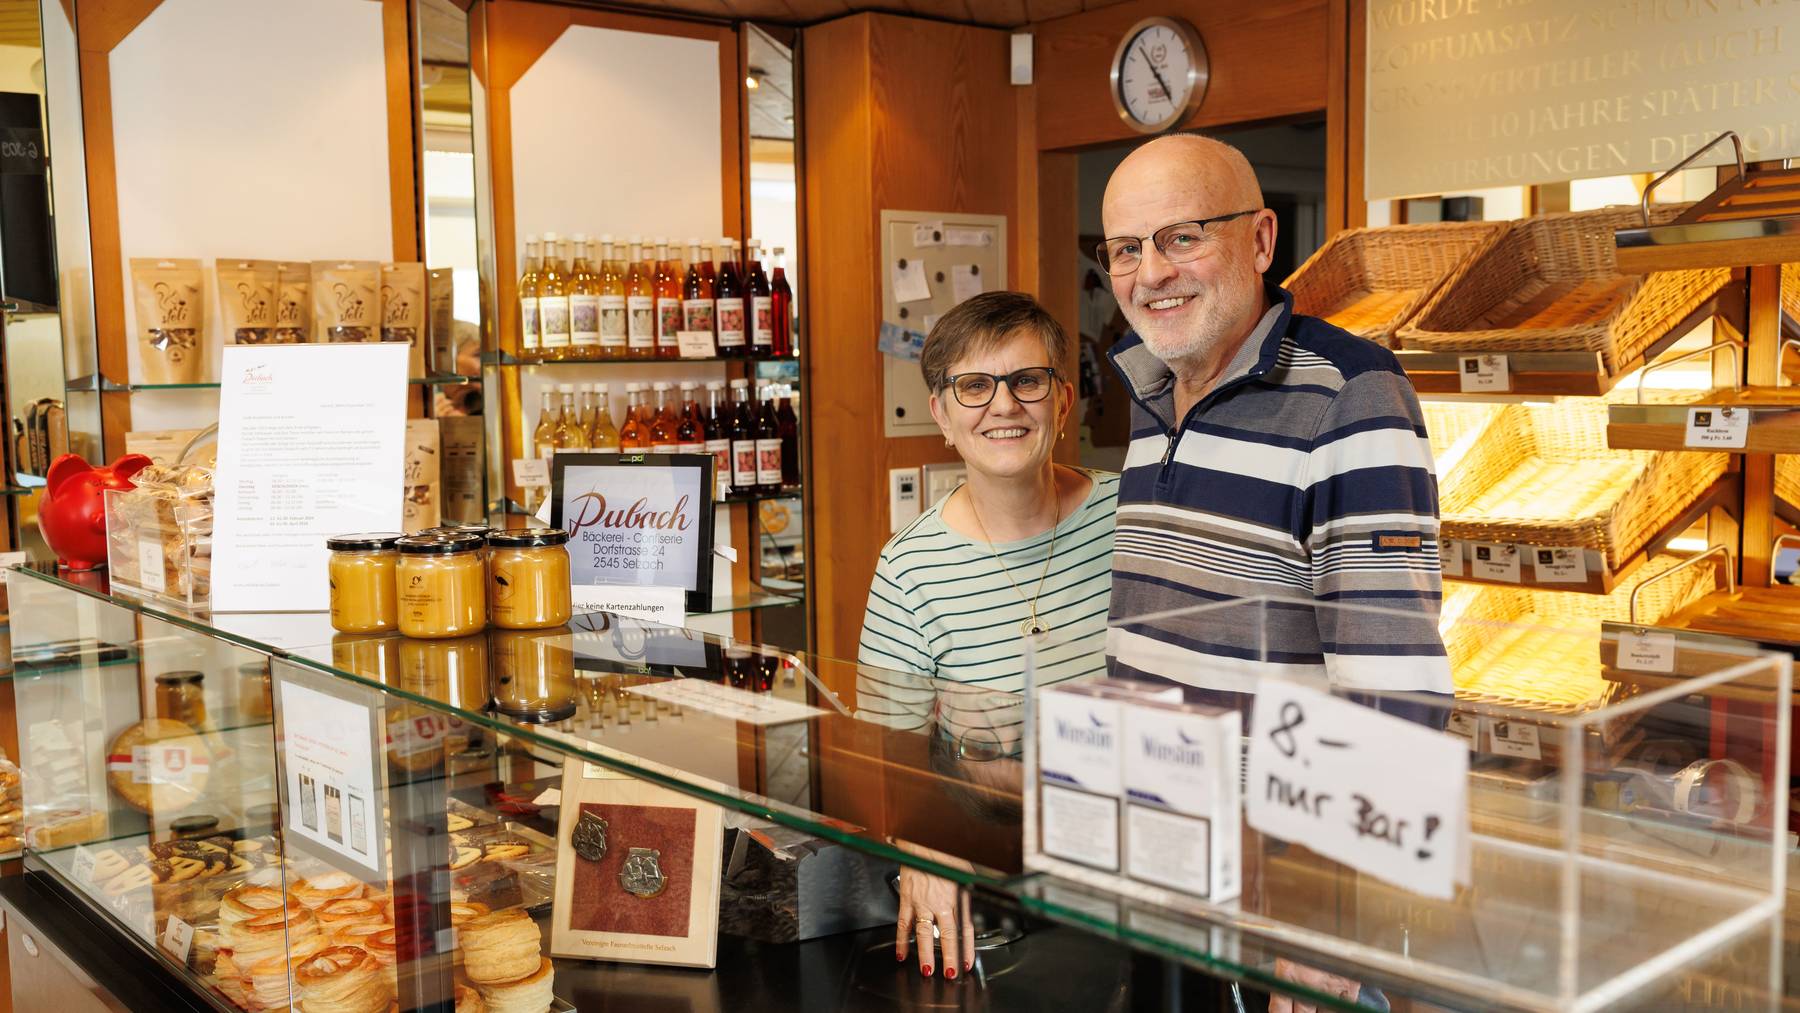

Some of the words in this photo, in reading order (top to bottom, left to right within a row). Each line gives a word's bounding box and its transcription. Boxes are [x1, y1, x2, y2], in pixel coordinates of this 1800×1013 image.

[1371, 15, 1581, 73] ZOPFUMSATZ
[1526, 96, 1634, 139] JAHRE
[1640, 76, 1777, 119] SPÄTER
[583, 531, 625, 542] Bäckerei
[633, 533, 683, 544] Confiserie
[593, 544, 648, 556] Dorfstrasse
[652, 545, 665, 556] 24
[593, 557, 620, 569] 2545
[586, 602, 604, 611] keine
[606, 603, 664, 613] Kartenzahlungen
[1266, 774, 1333, 818] nur
